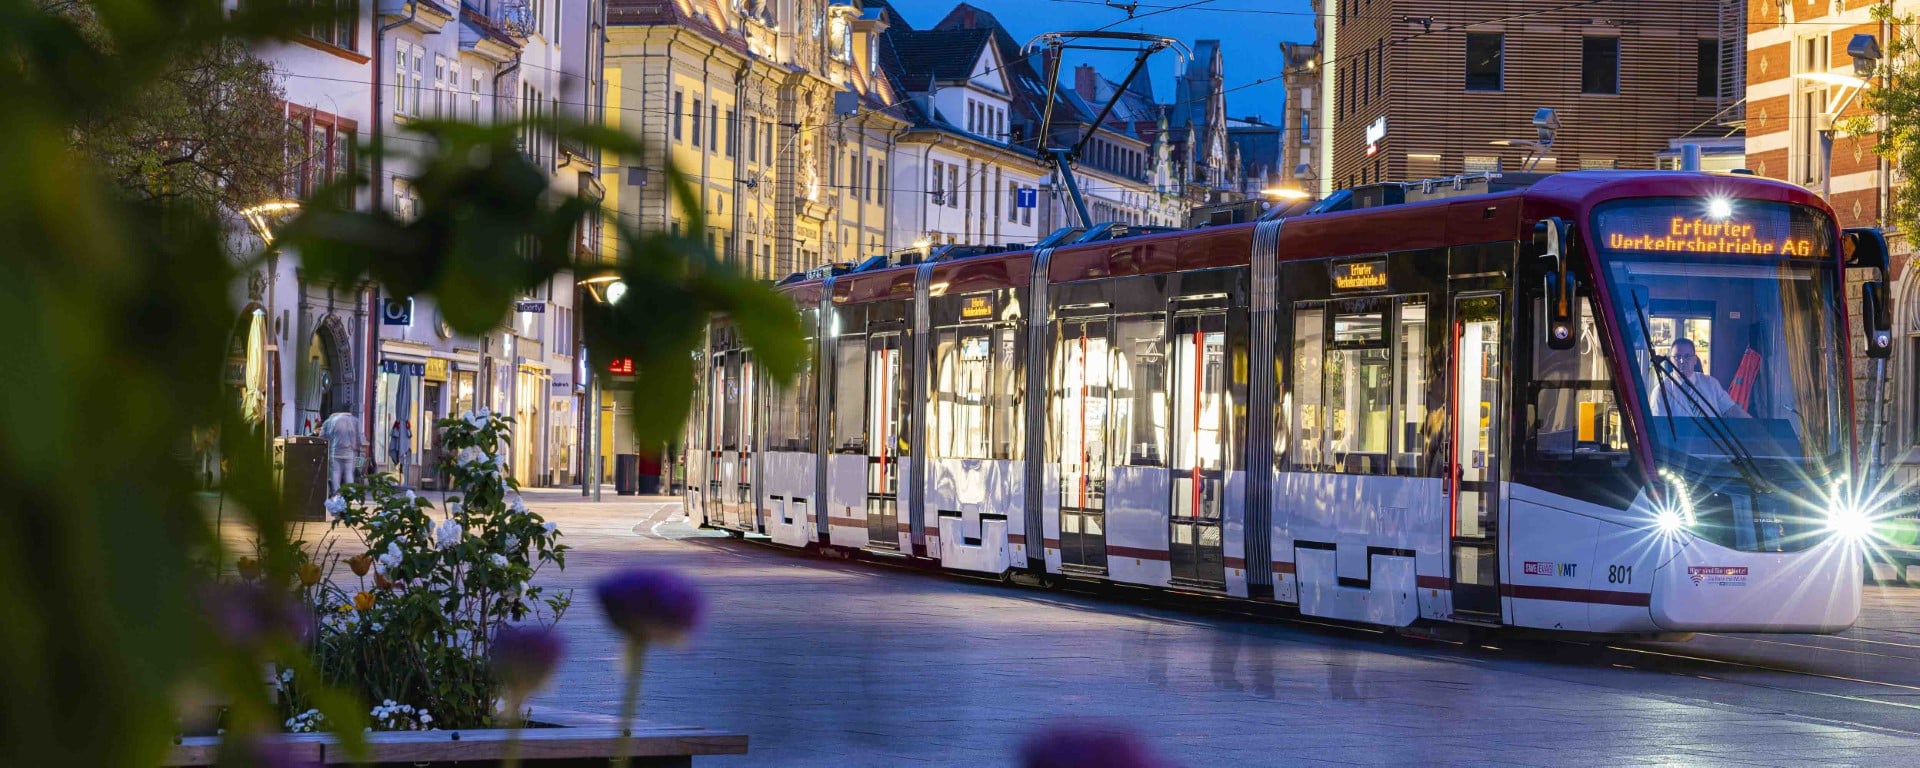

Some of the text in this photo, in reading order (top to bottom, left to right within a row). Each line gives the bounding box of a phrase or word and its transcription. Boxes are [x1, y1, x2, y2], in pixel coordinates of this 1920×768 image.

[1671, 216, 1752, 237] Erfurter
[1780, 239, 1810, 257] AG
[1557, 563, 1577, 577] VMT
[1608, 564, 1633, 584] 801
